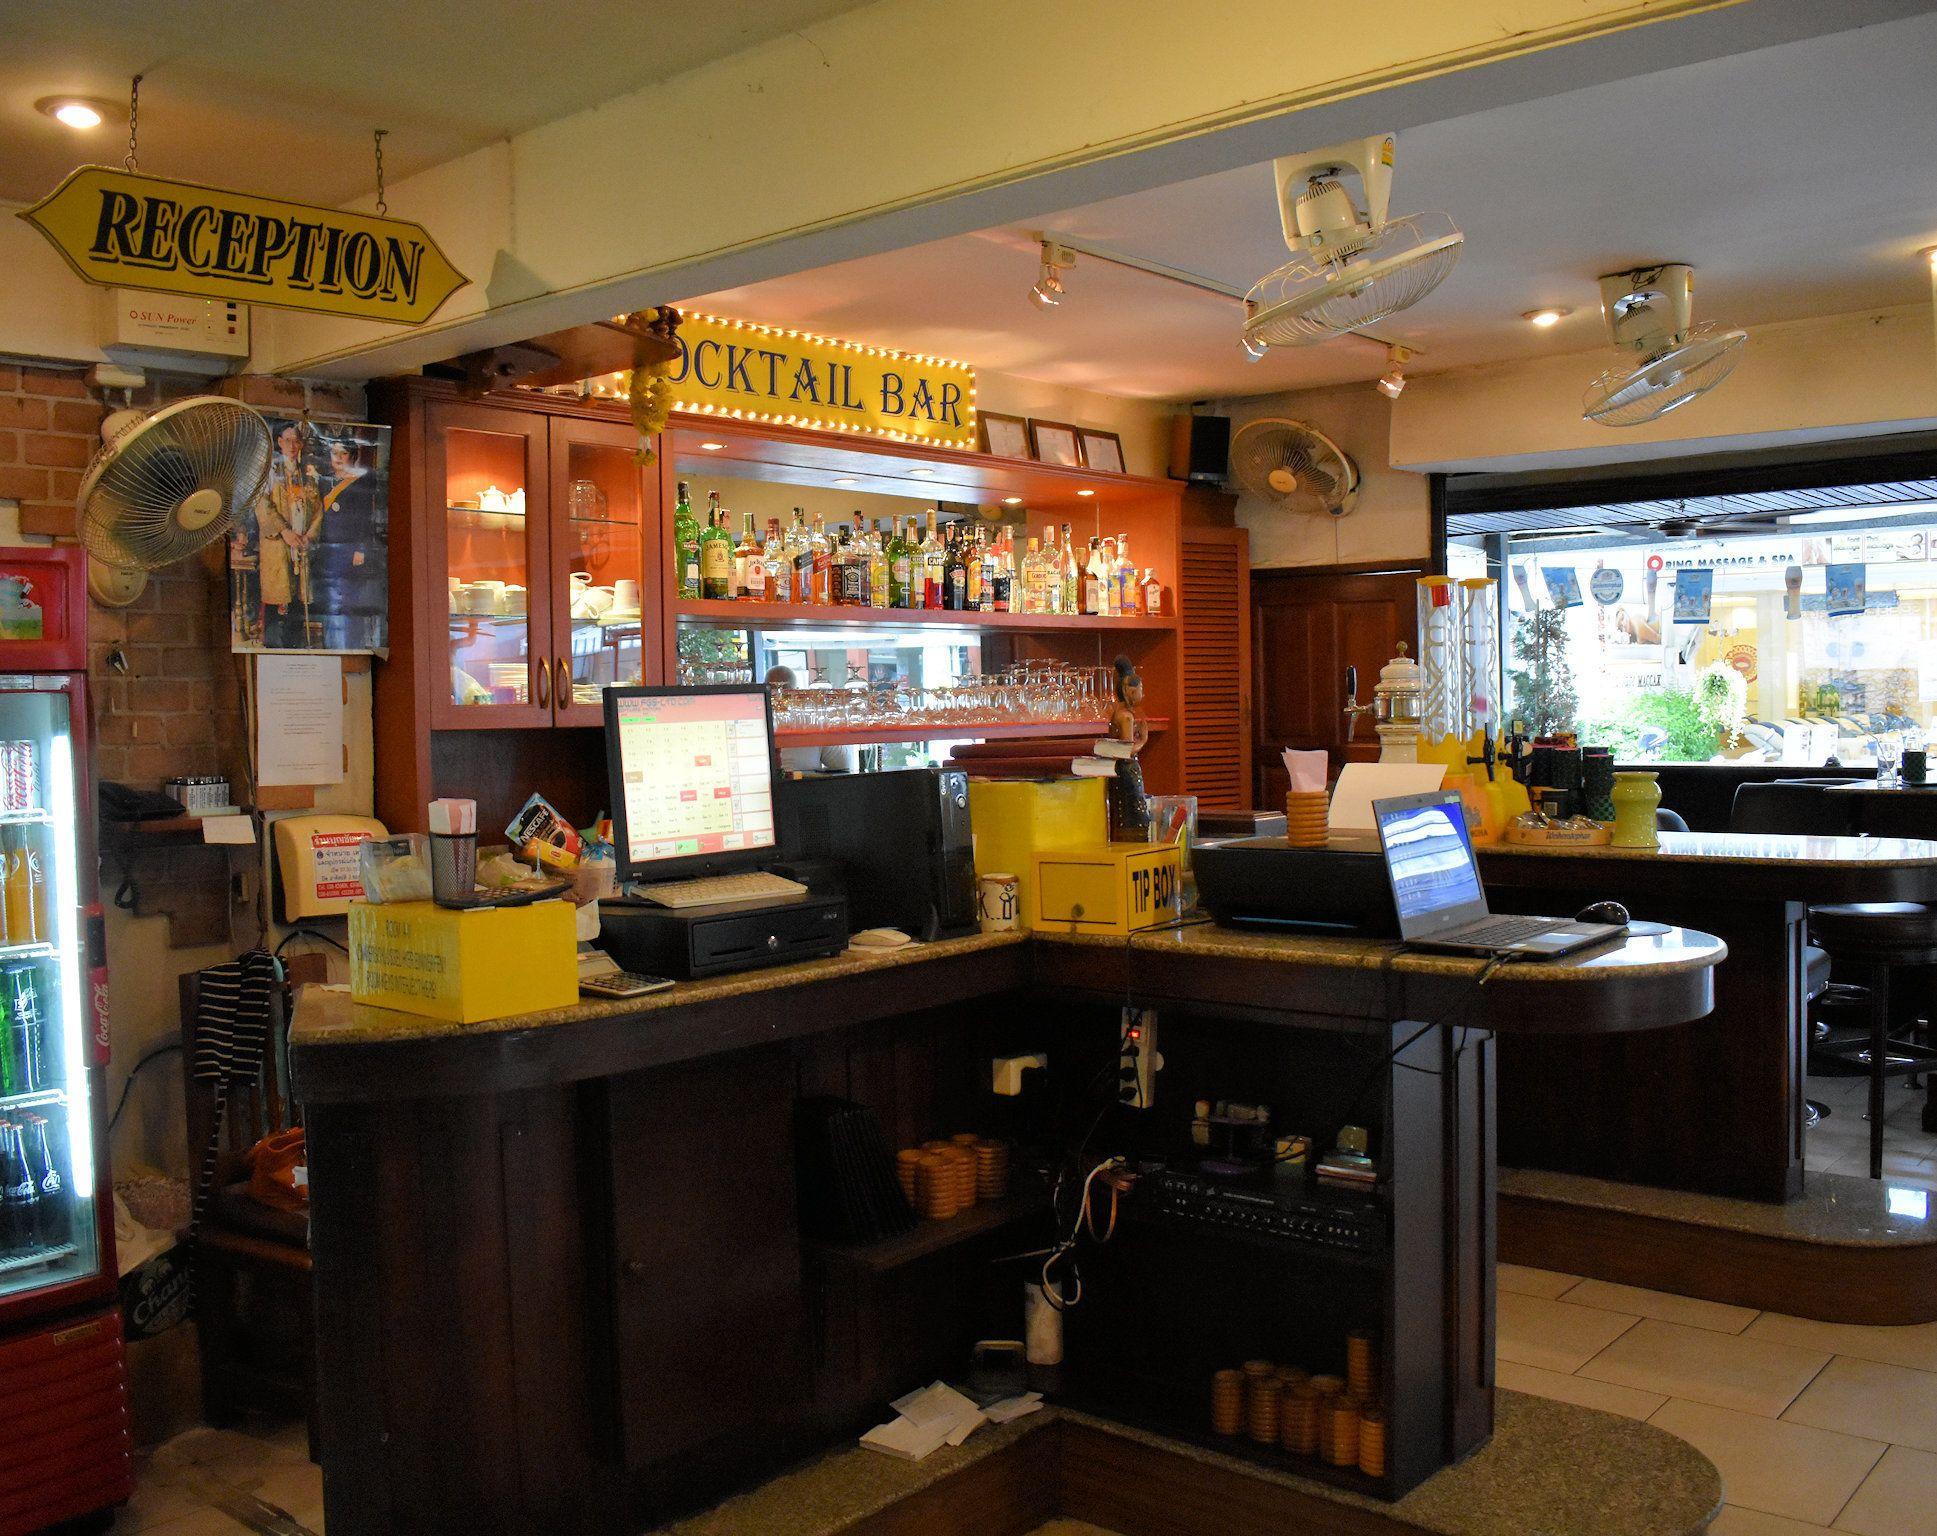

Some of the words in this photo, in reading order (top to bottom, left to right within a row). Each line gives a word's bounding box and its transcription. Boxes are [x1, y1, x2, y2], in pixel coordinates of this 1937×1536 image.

[89, 189, 425, 304] RECEPTION
[166, 313, 197, 325] Power
[667, 335, 865, 411] OCKTAIL
[880, 372, 964, 429] BAR
[1665, 560, 1693, 569] RING
[1697, 556, 1754, 568] MASSAGE
[1759, 556, 1767, 565] &
[1771, 554, 1795, 564] SPA
[1133, 868, 1150, 913] TIP
[1153, 864, 1176, 909] BOX
